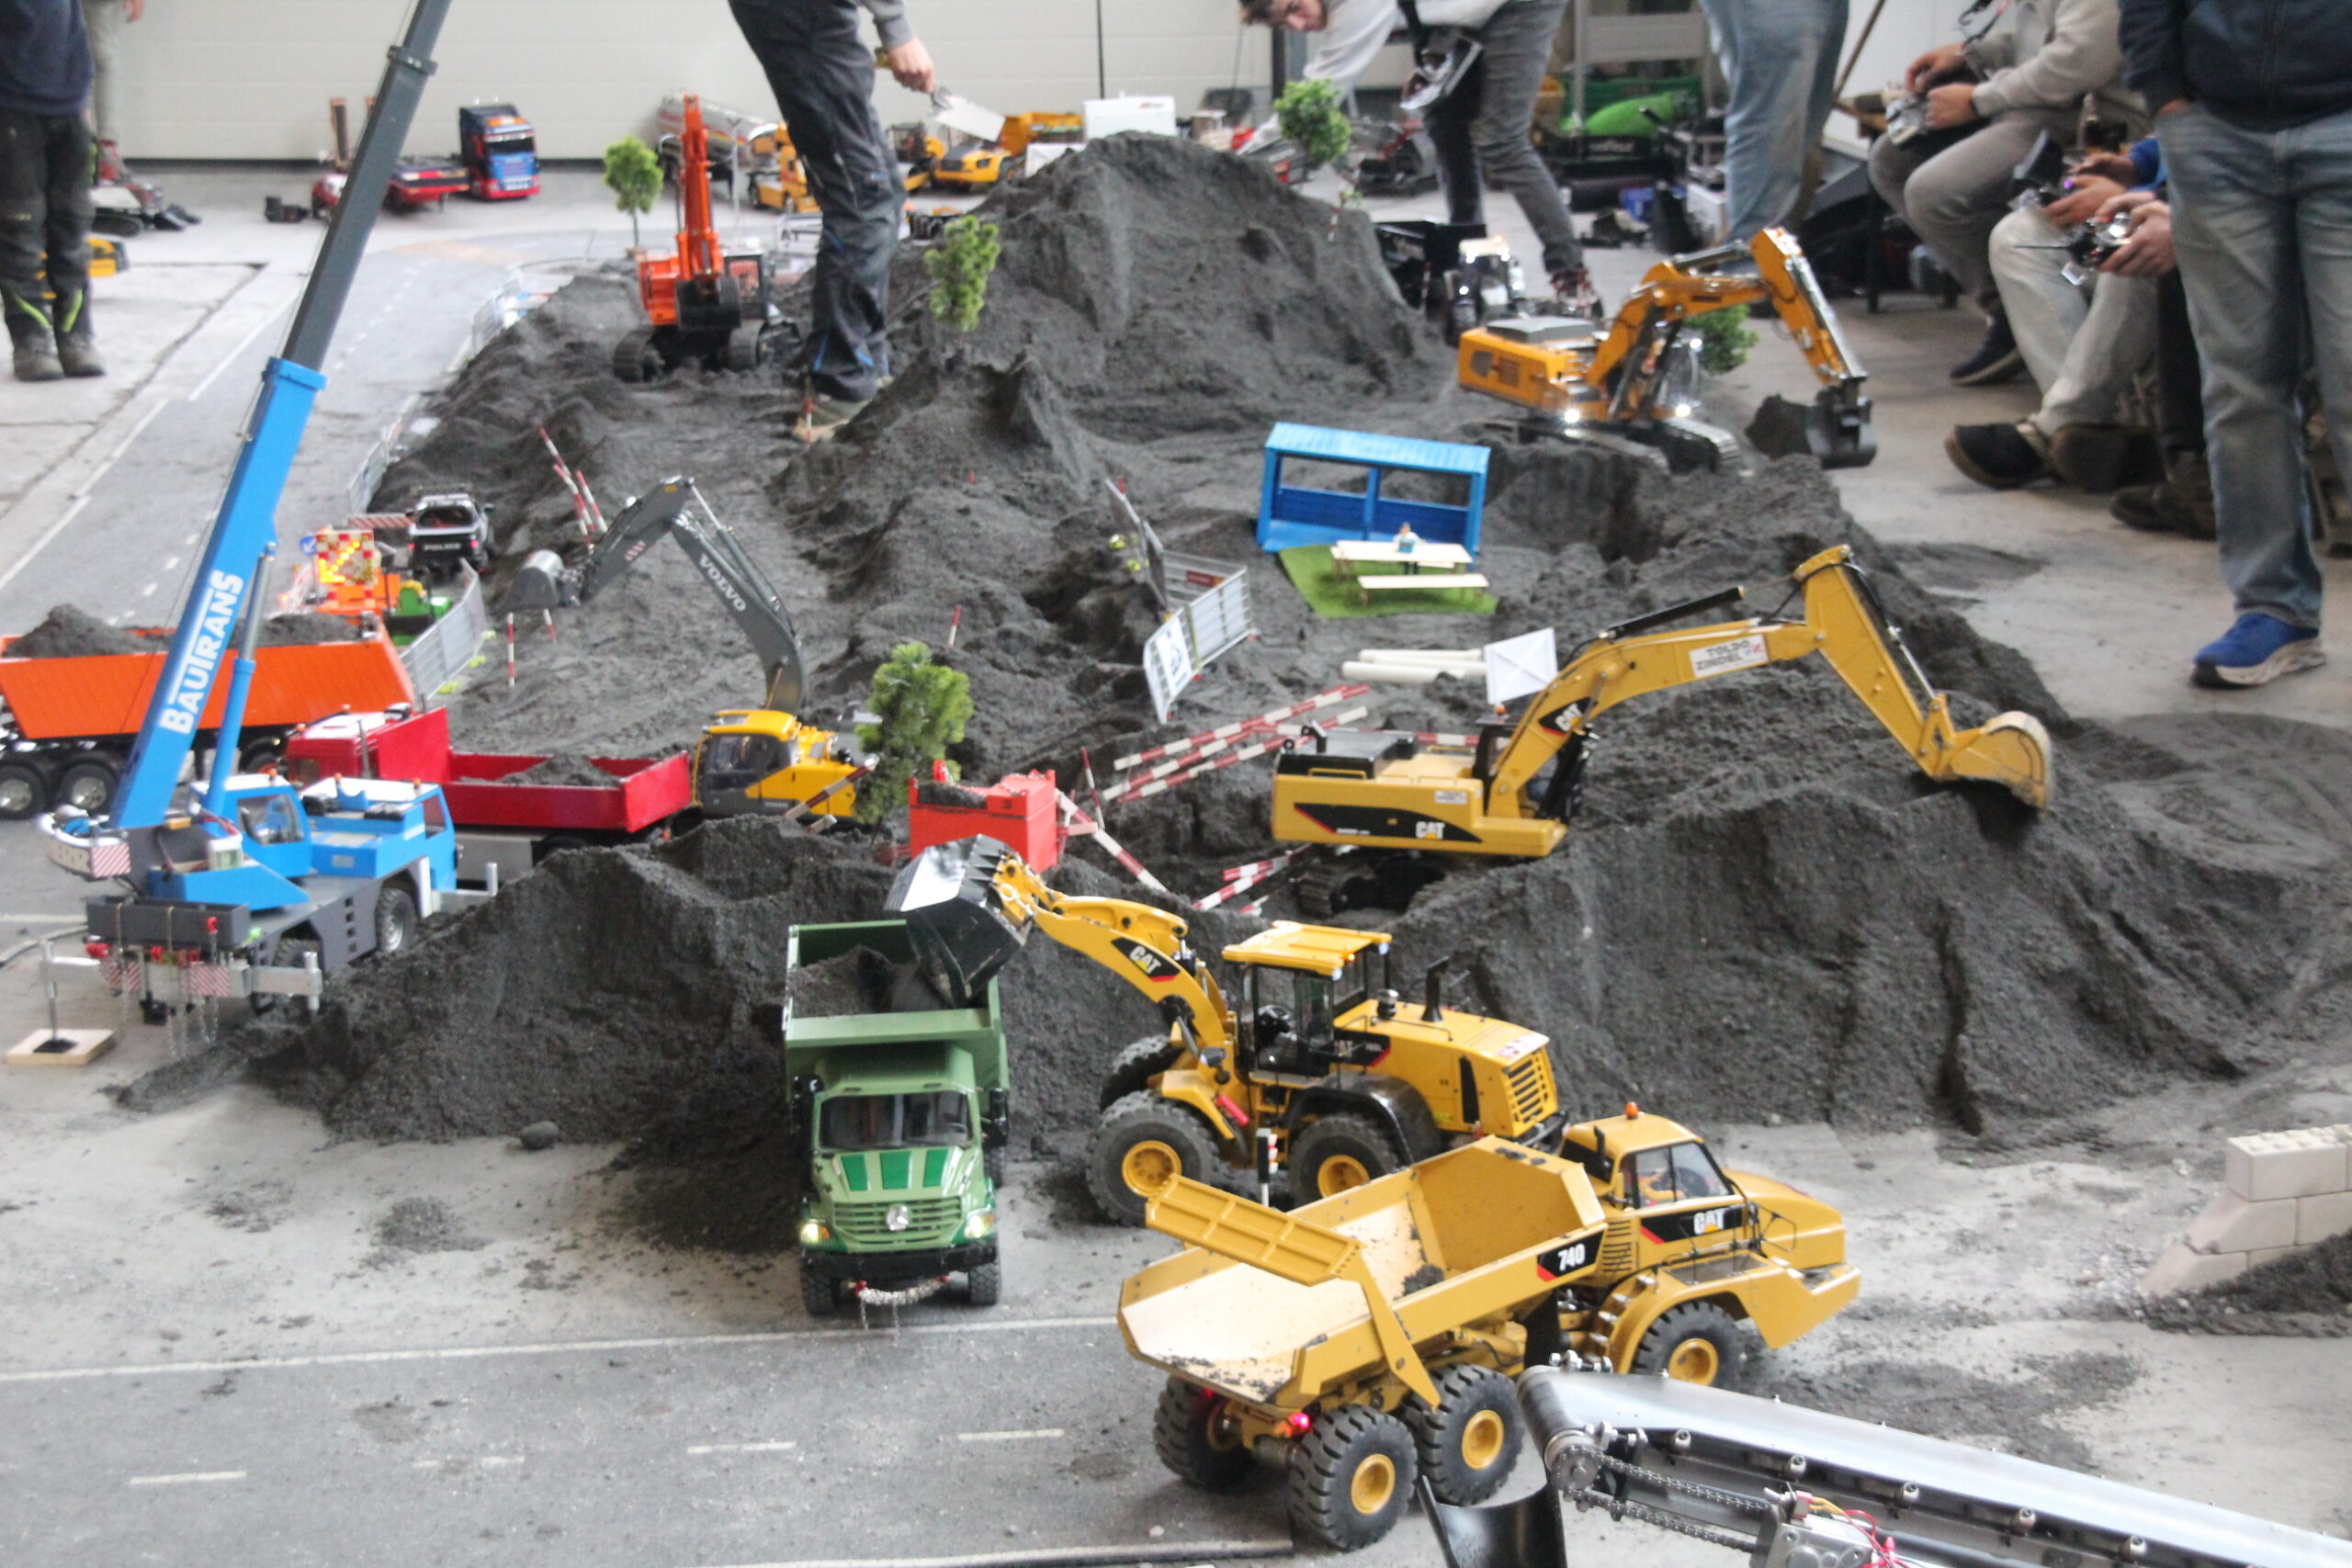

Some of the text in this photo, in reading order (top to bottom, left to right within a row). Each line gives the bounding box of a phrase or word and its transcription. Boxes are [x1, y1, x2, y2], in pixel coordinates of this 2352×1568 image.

[700, 553, 746, 612] VOLVO
[159, 570, 243, 735] BAUTRANS
[1555, 703, 1583, 732] CAT
[1416, 821, 1445, 840] CAT
[1130, 945, 1161, 974] CAT
[1693, 1208, 1727, 1235] CAT
[1557, 1243, 1586, 1271] 740
